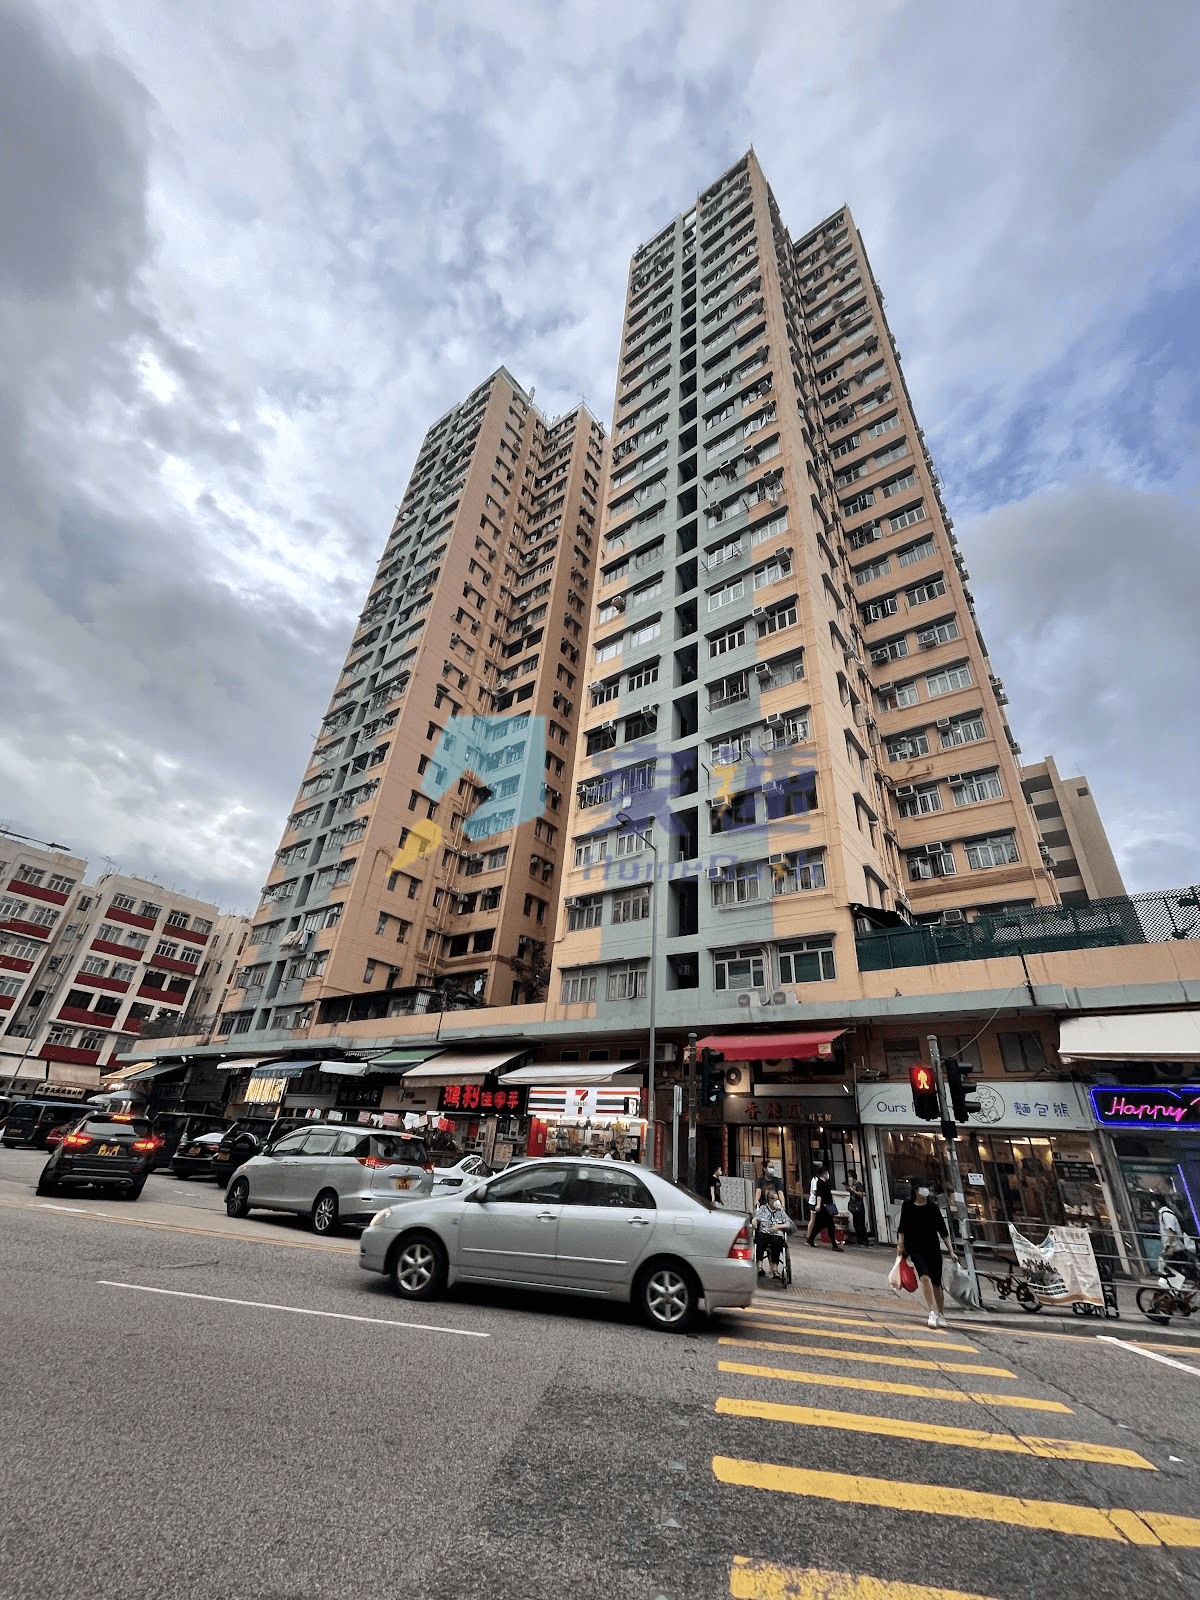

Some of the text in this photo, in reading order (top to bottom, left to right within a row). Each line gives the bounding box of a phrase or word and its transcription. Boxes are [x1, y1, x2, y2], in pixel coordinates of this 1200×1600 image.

[876, 1101, 907, 1113] Ours
[1013, 1101, 1070, 1118] 麵包熊
[1104, 1096, 1188, 1122] Happy
